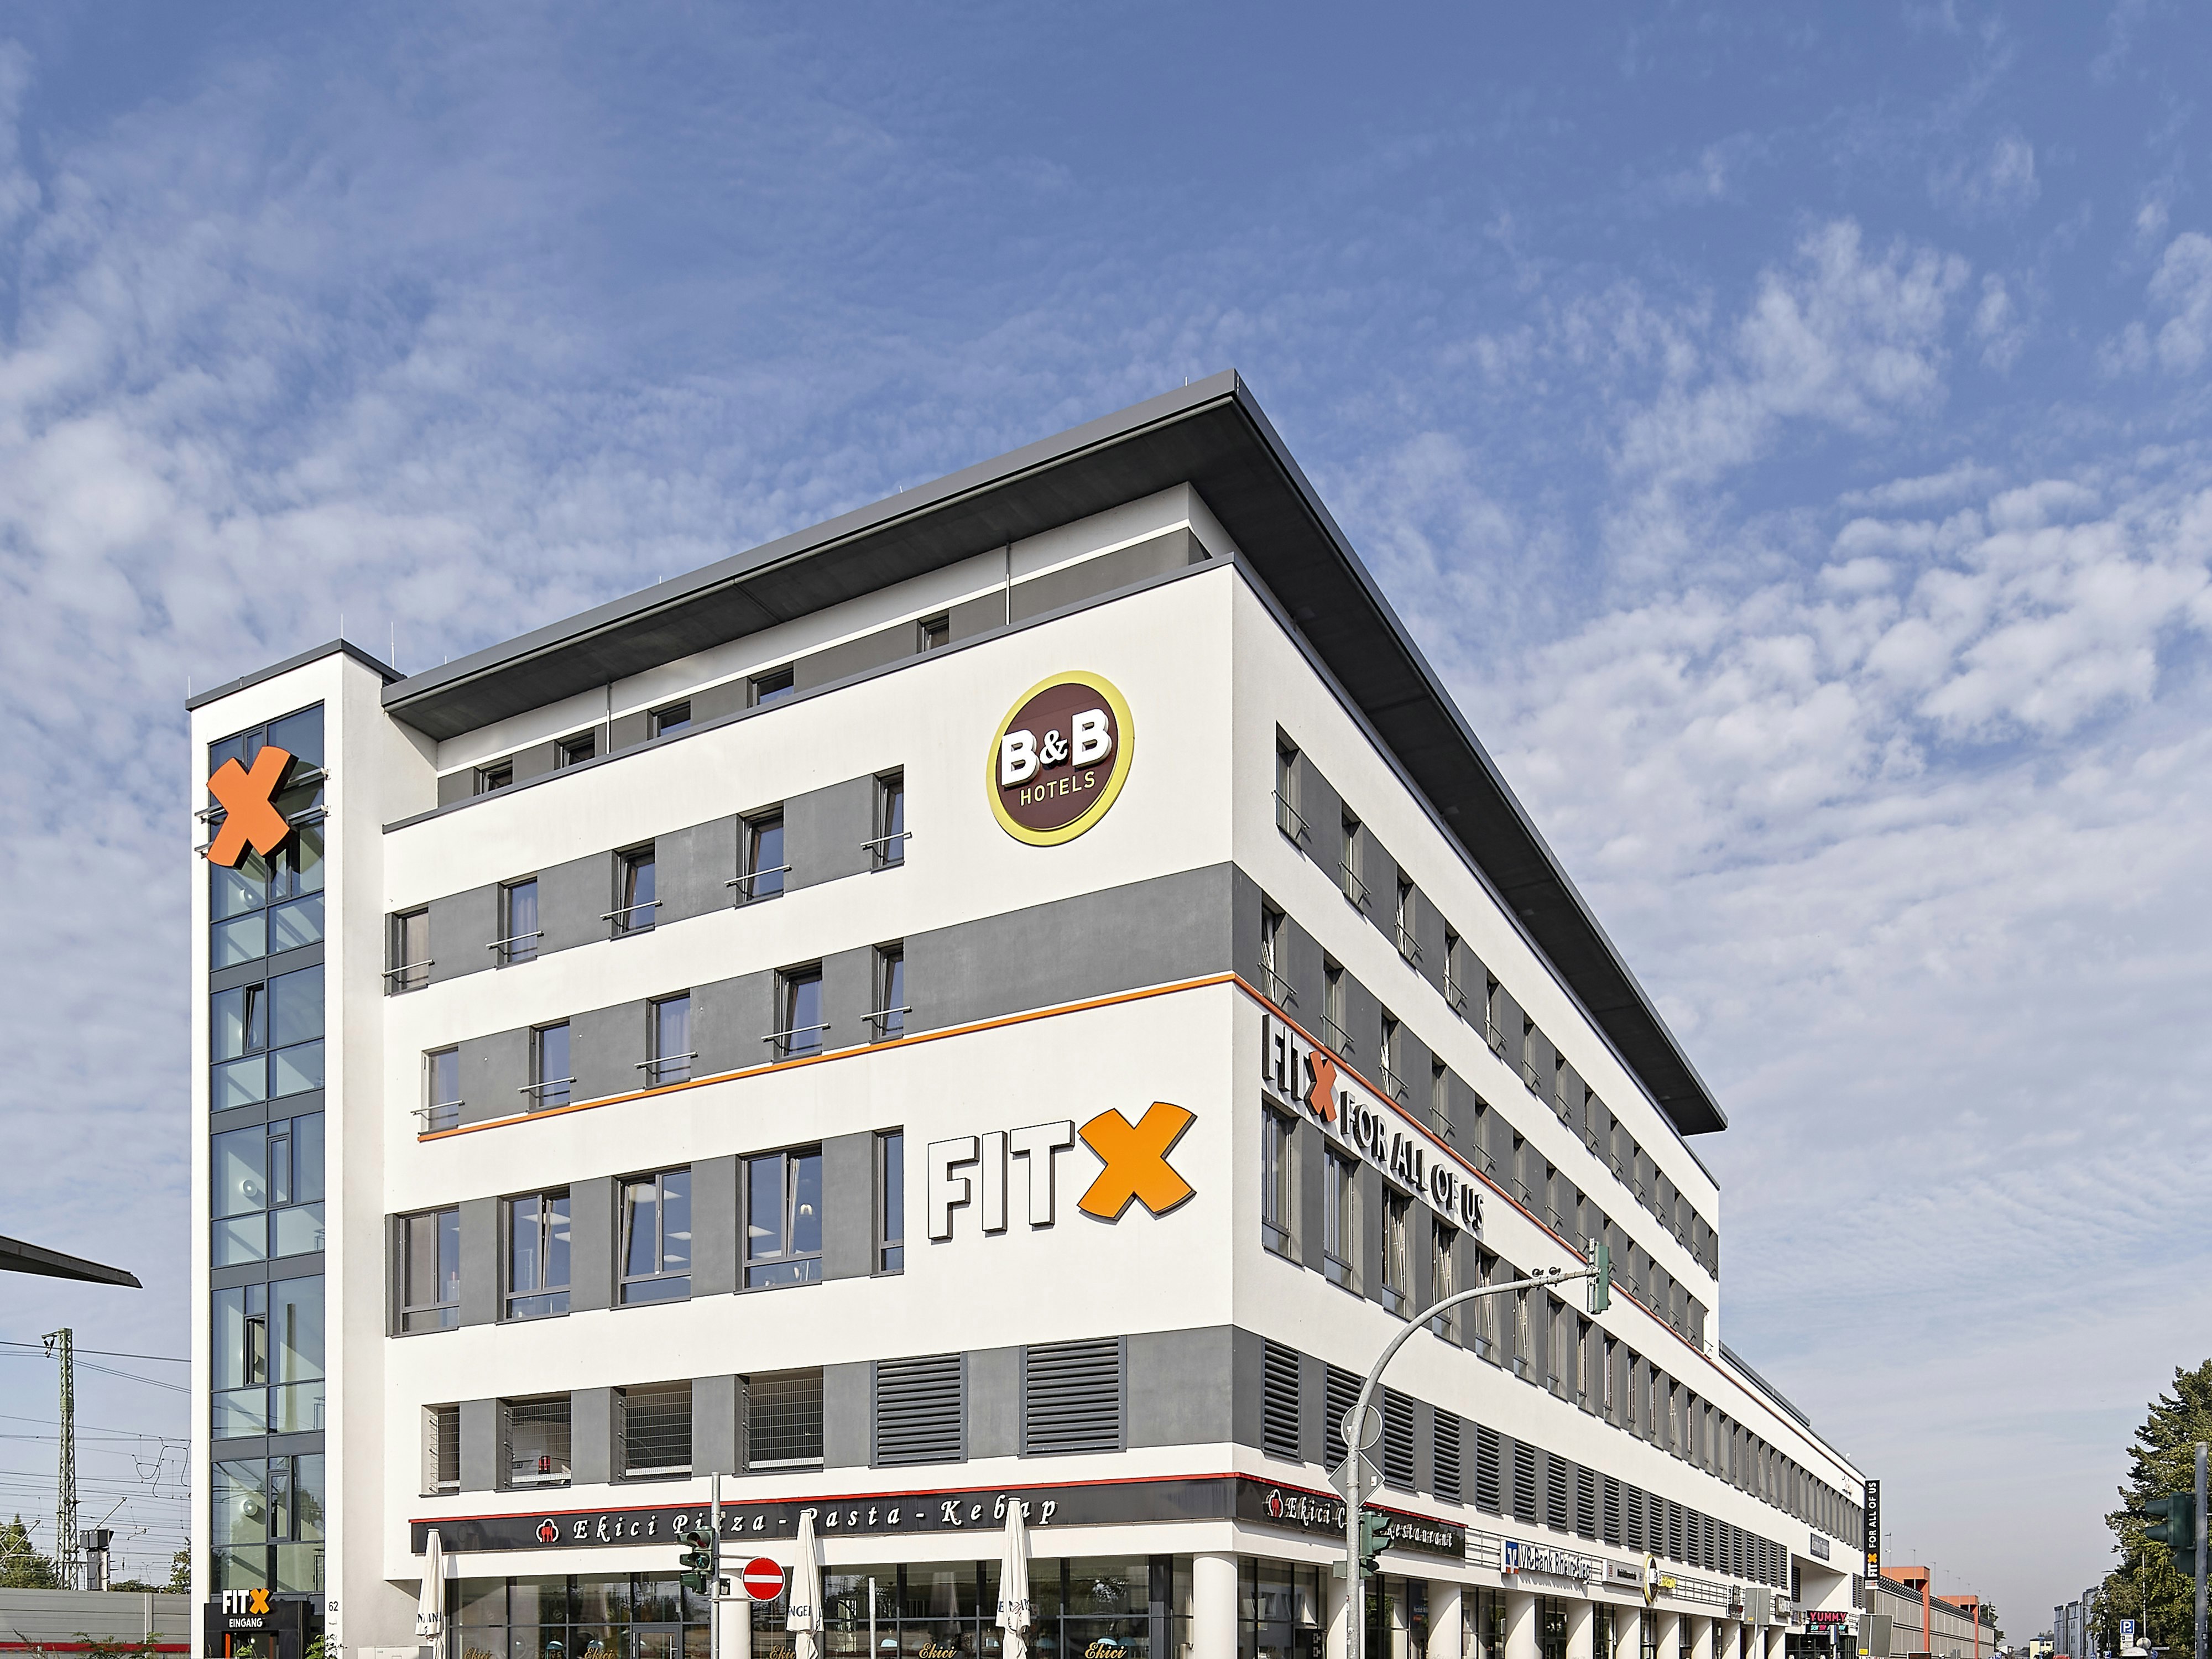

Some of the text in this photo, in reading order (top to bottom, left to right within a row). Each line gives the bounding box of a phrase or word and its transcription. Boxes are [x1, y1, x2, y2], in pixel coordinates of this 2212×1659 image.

[1001, 708, 1112, 786] B&B
[1020, 771, 1095, 806] HOTELS
[1262, 1014, 1484, 1230] FITX FOR ALL OF US
[928, 1102, 1197, 1240] FITX
[1869, 1483, 1876, 1494] US
[1288, 1496, 1330, 1526] Ekici
[1869, 1497, 1876, 1509] OF
[573, 1515, 657, 1542] Ekici
[672, 1512, 765, 1533] Piza
[1867, 1553, 1877, 1577] FITX
[222, 1588, 269, 1614] FITX
[329, 1601, 338, 1611] 62
[228, 1618, 263, 1627] EINGANG
[1810, 1611, 1846, 1623] YUMMY
[919, 1642, 957, 1659] Ekici
[1084, 1641, 1128, 1659] Ekici
